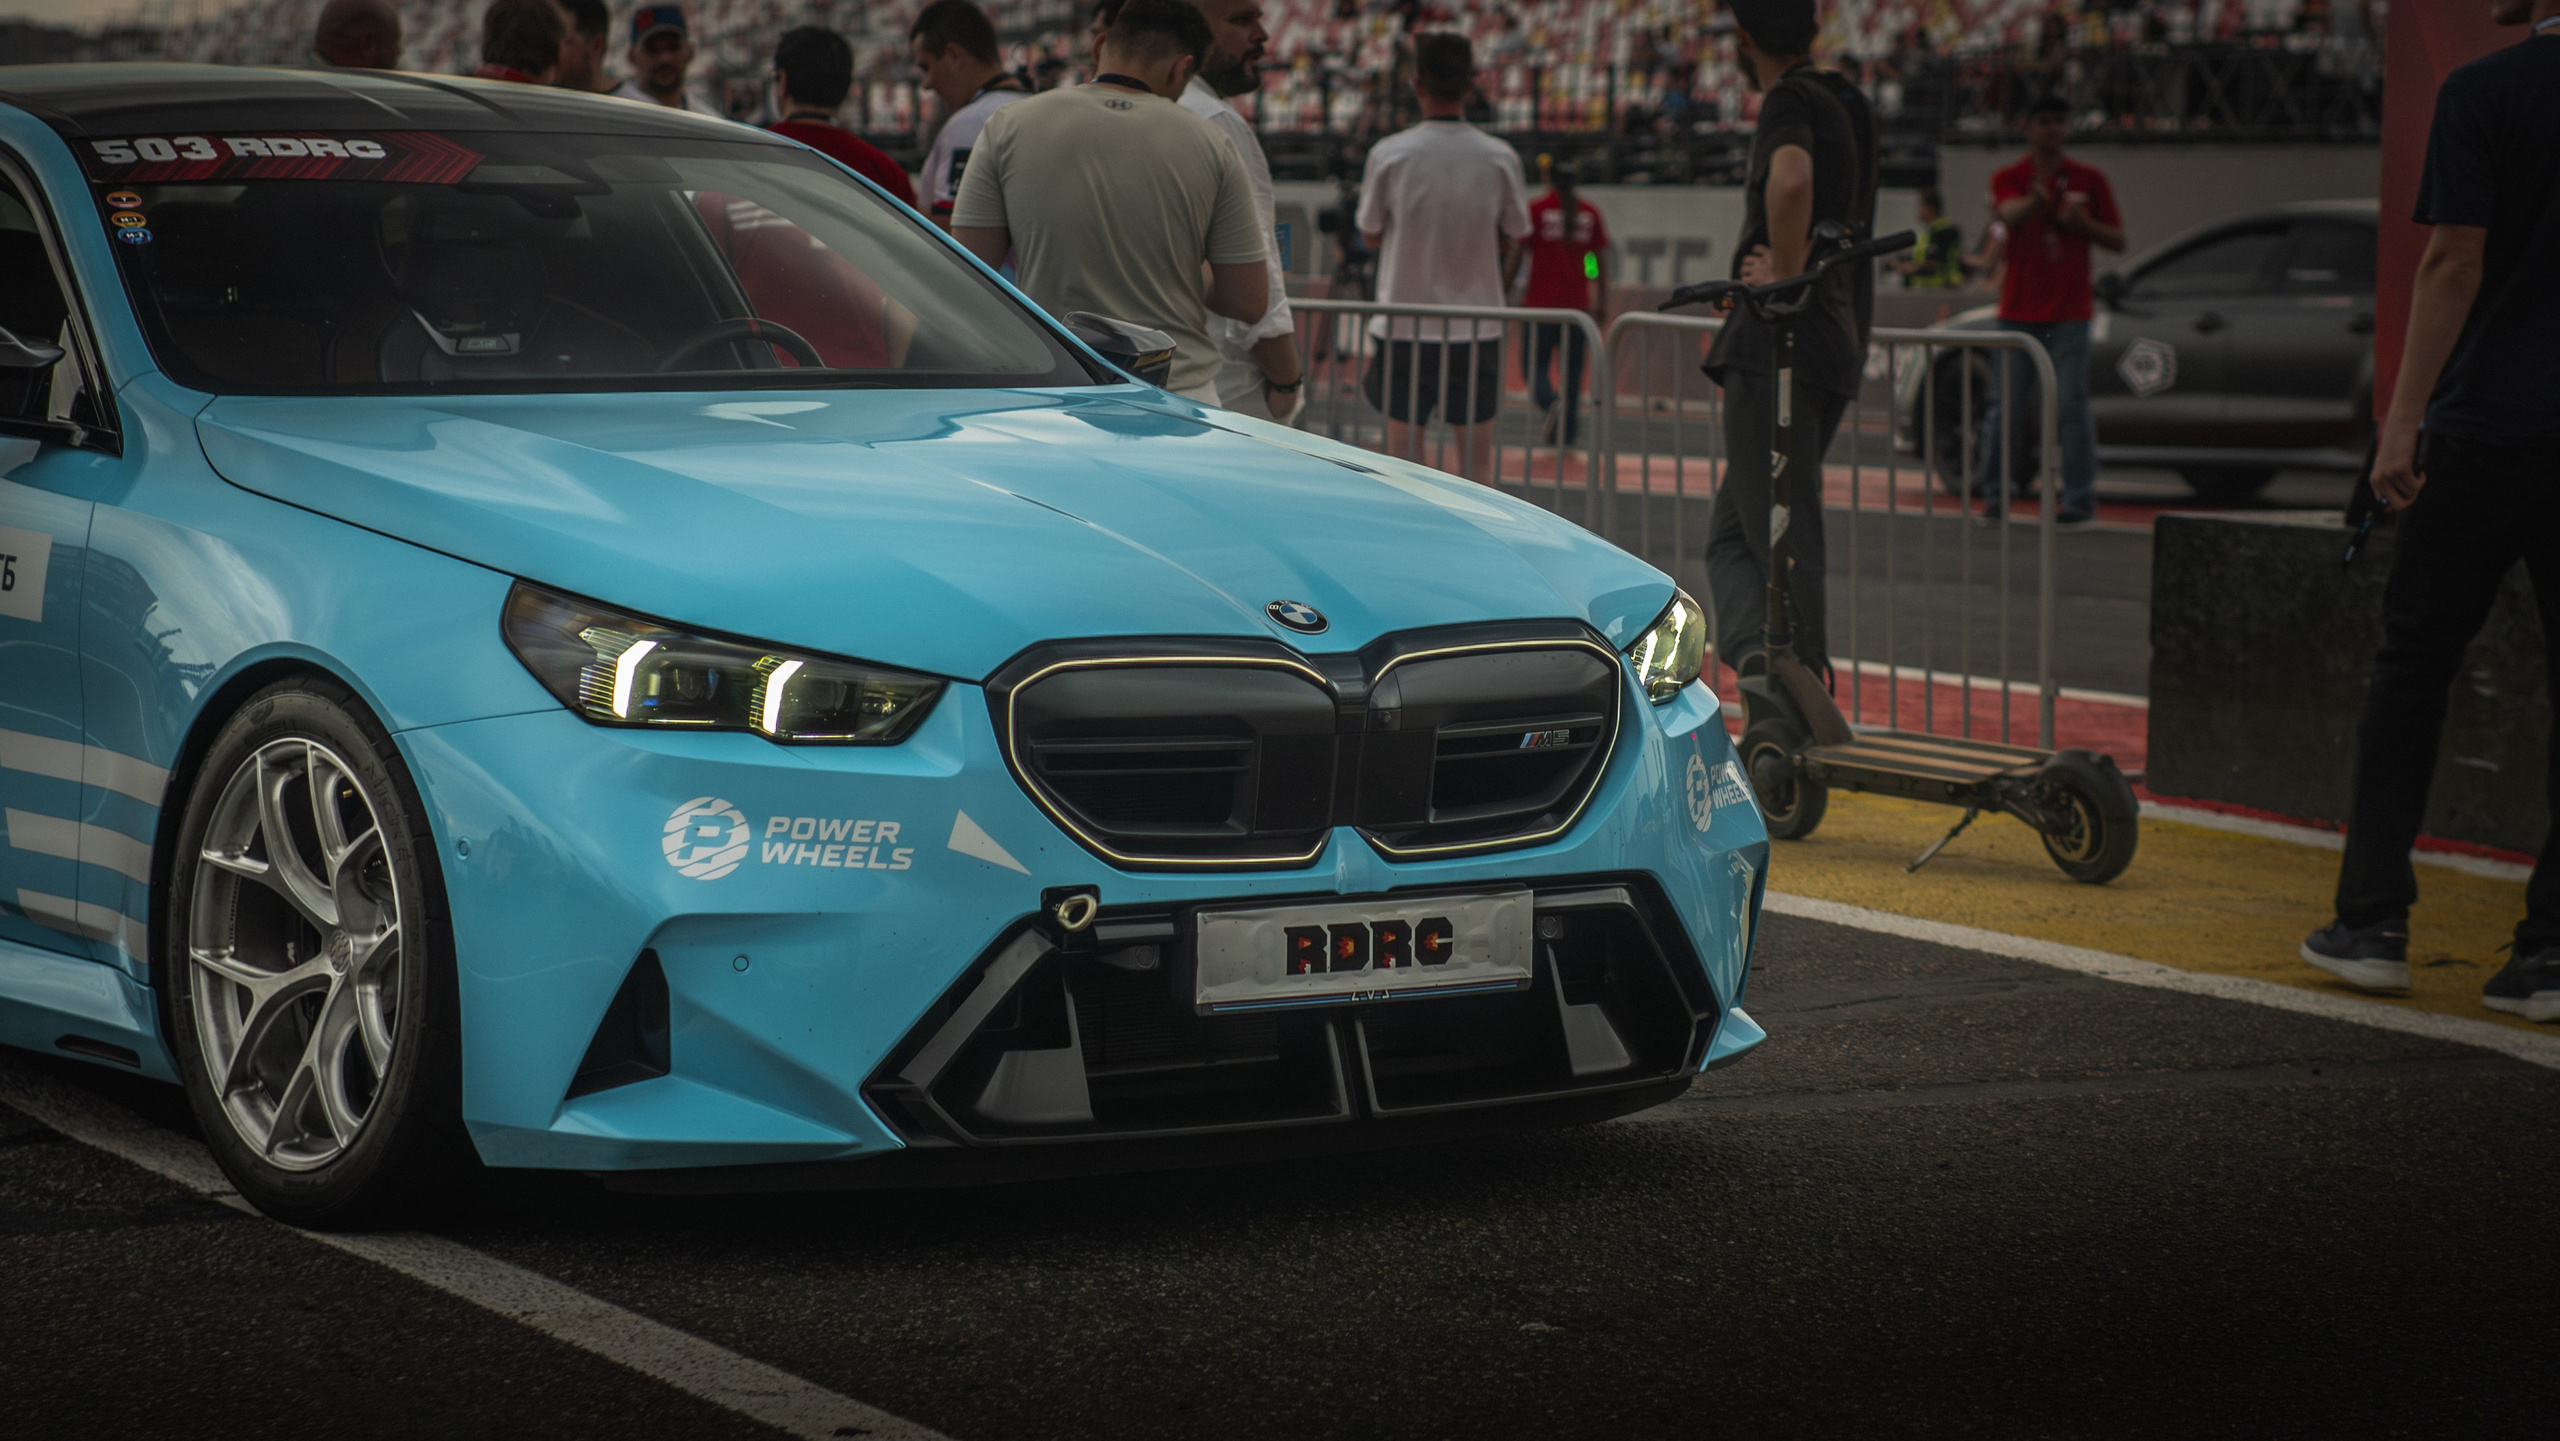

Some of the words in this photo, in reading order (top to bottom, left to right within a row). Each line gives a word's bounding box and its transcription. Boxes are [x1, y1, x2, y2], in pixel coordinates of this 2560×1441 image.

[91, 136, 217, 164] 503
[222, 137, 386, 158] RDRC
[1534, 729, 1570, 748] M5
[765, 817, 901, 844] POWER
[762, 842, 915, 870] WHEELS
[1284, 917, 1454, 976] RDRC
